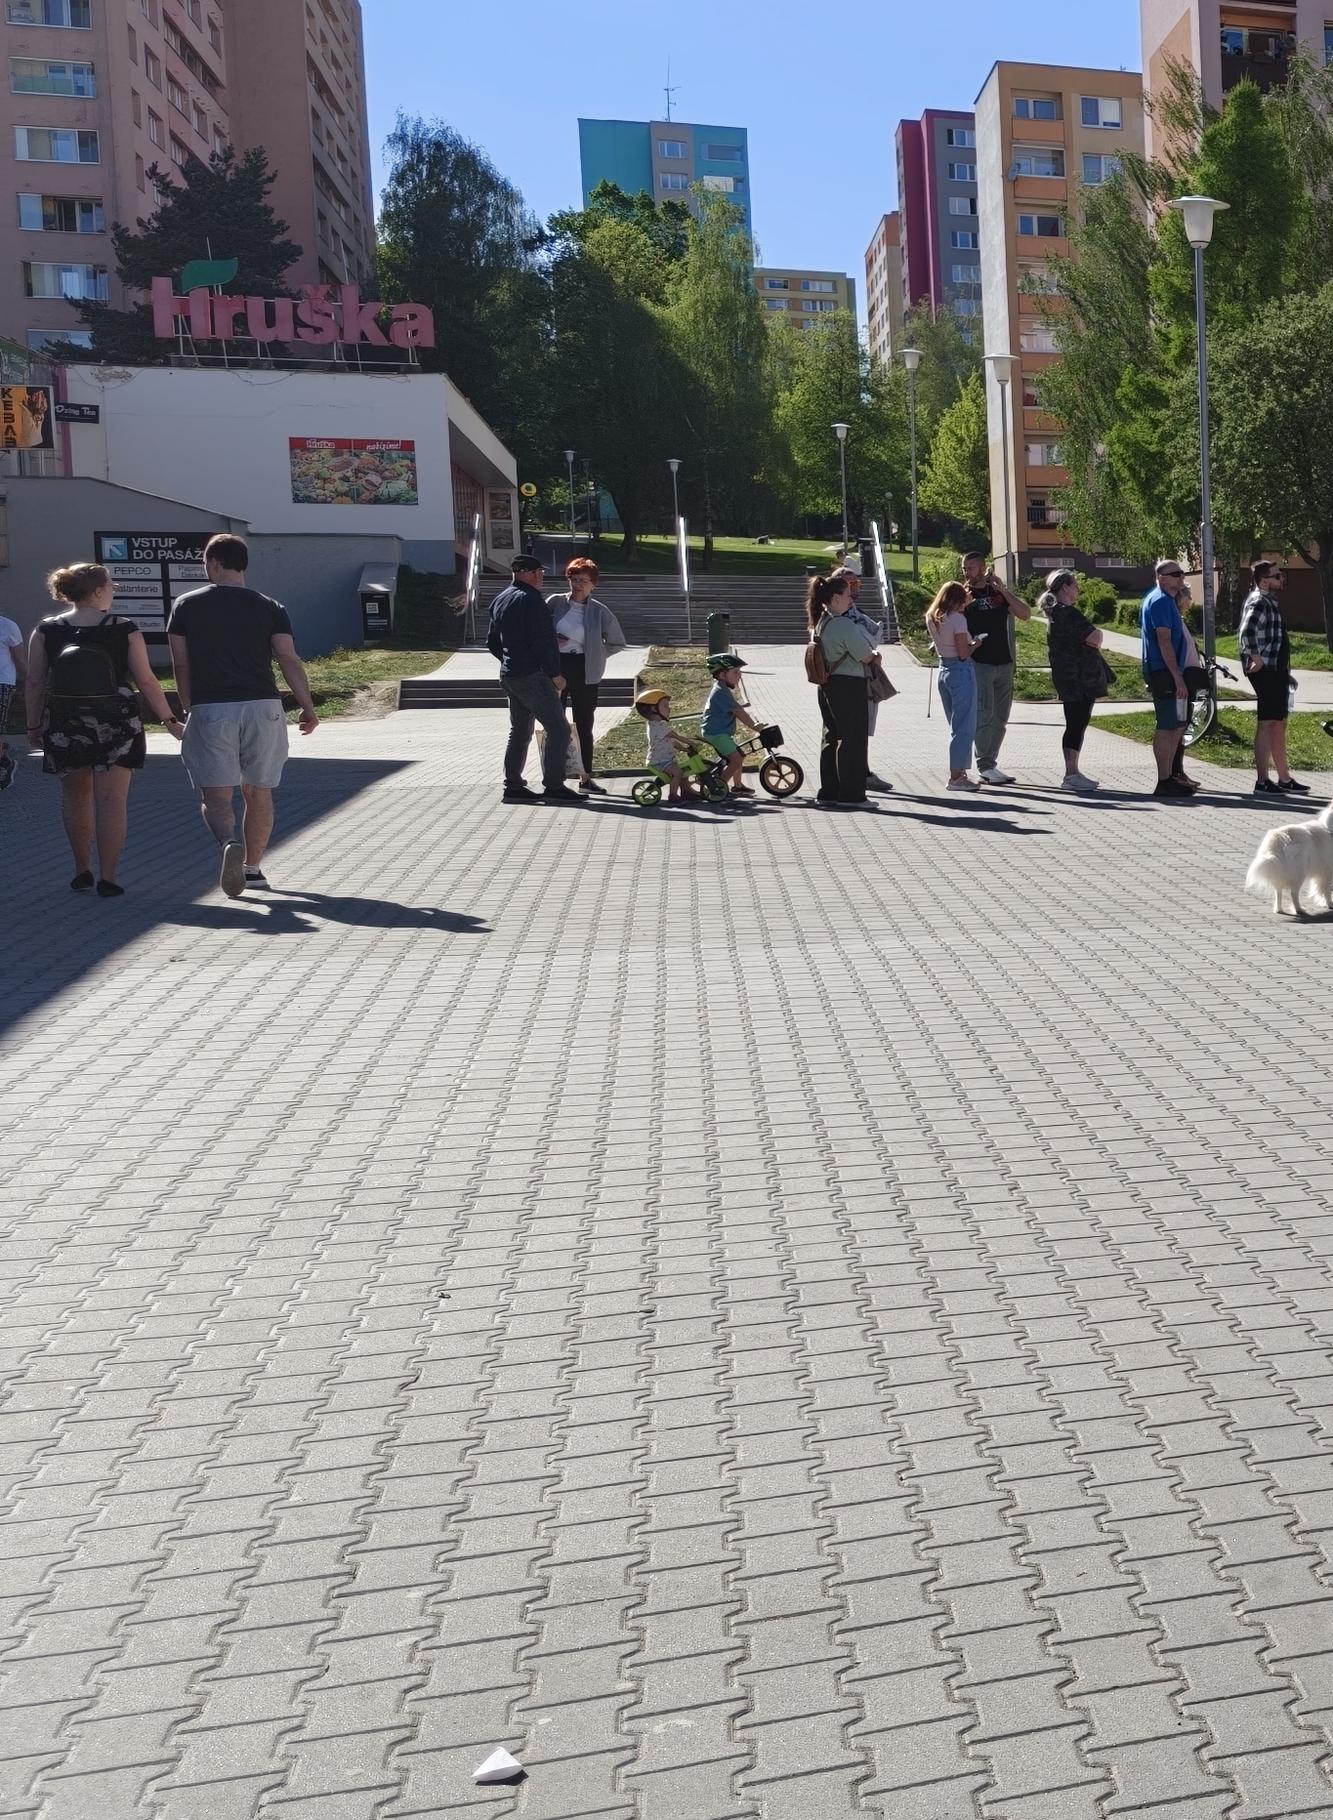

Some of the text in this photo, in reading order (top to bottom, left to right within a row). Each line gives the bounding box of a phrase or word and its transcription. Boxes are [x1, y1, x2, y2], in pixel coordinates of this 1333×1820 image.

[152, 277, 436, 349] Hruška
[131, 538, 178, 548] VSTUP
[133, 547, 205, 560] DO PASÁŽ
[113, 566, 152, 575] PEPCO
[117, 584, 158, 593] alanterie
